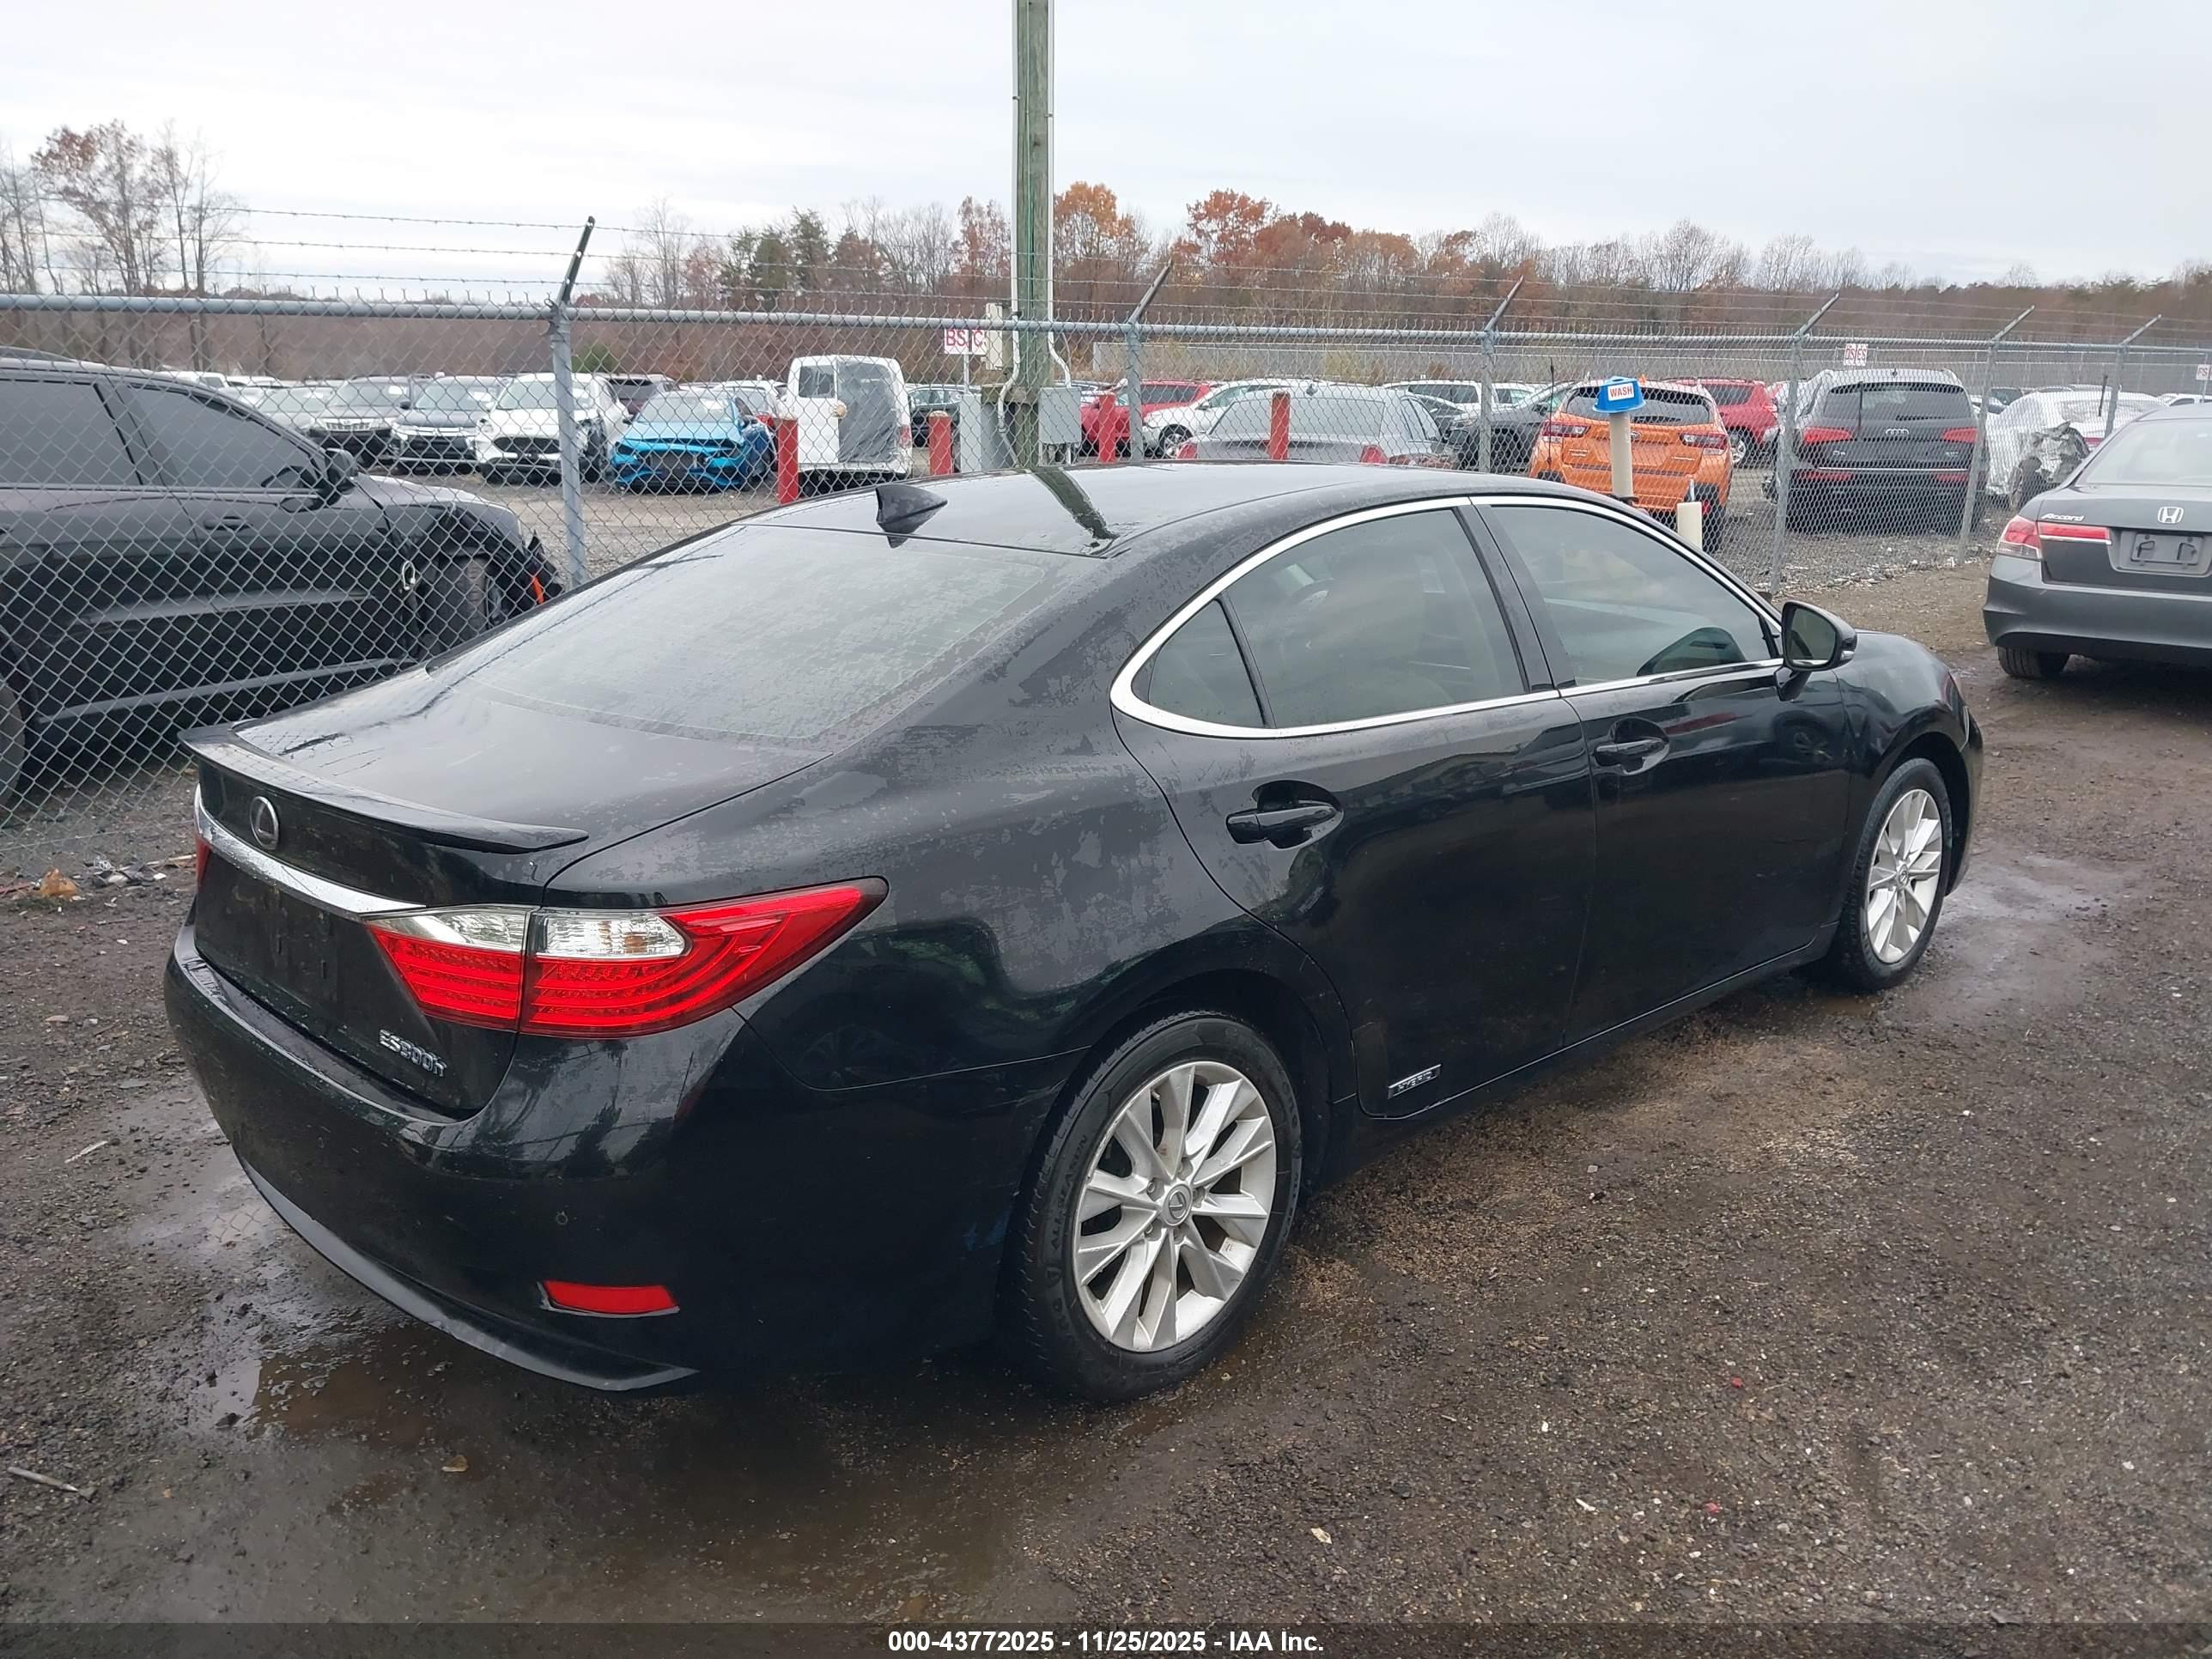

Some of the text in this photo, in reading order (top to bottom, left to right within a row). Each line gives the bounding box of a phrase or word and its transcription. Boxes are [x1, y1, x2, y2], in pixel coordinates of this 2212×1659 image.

[1609, 386, 1632, 398] WASH
[2041, 513, 2085, 522] Accord
[380, 1029, 447, 1077] ES300h
